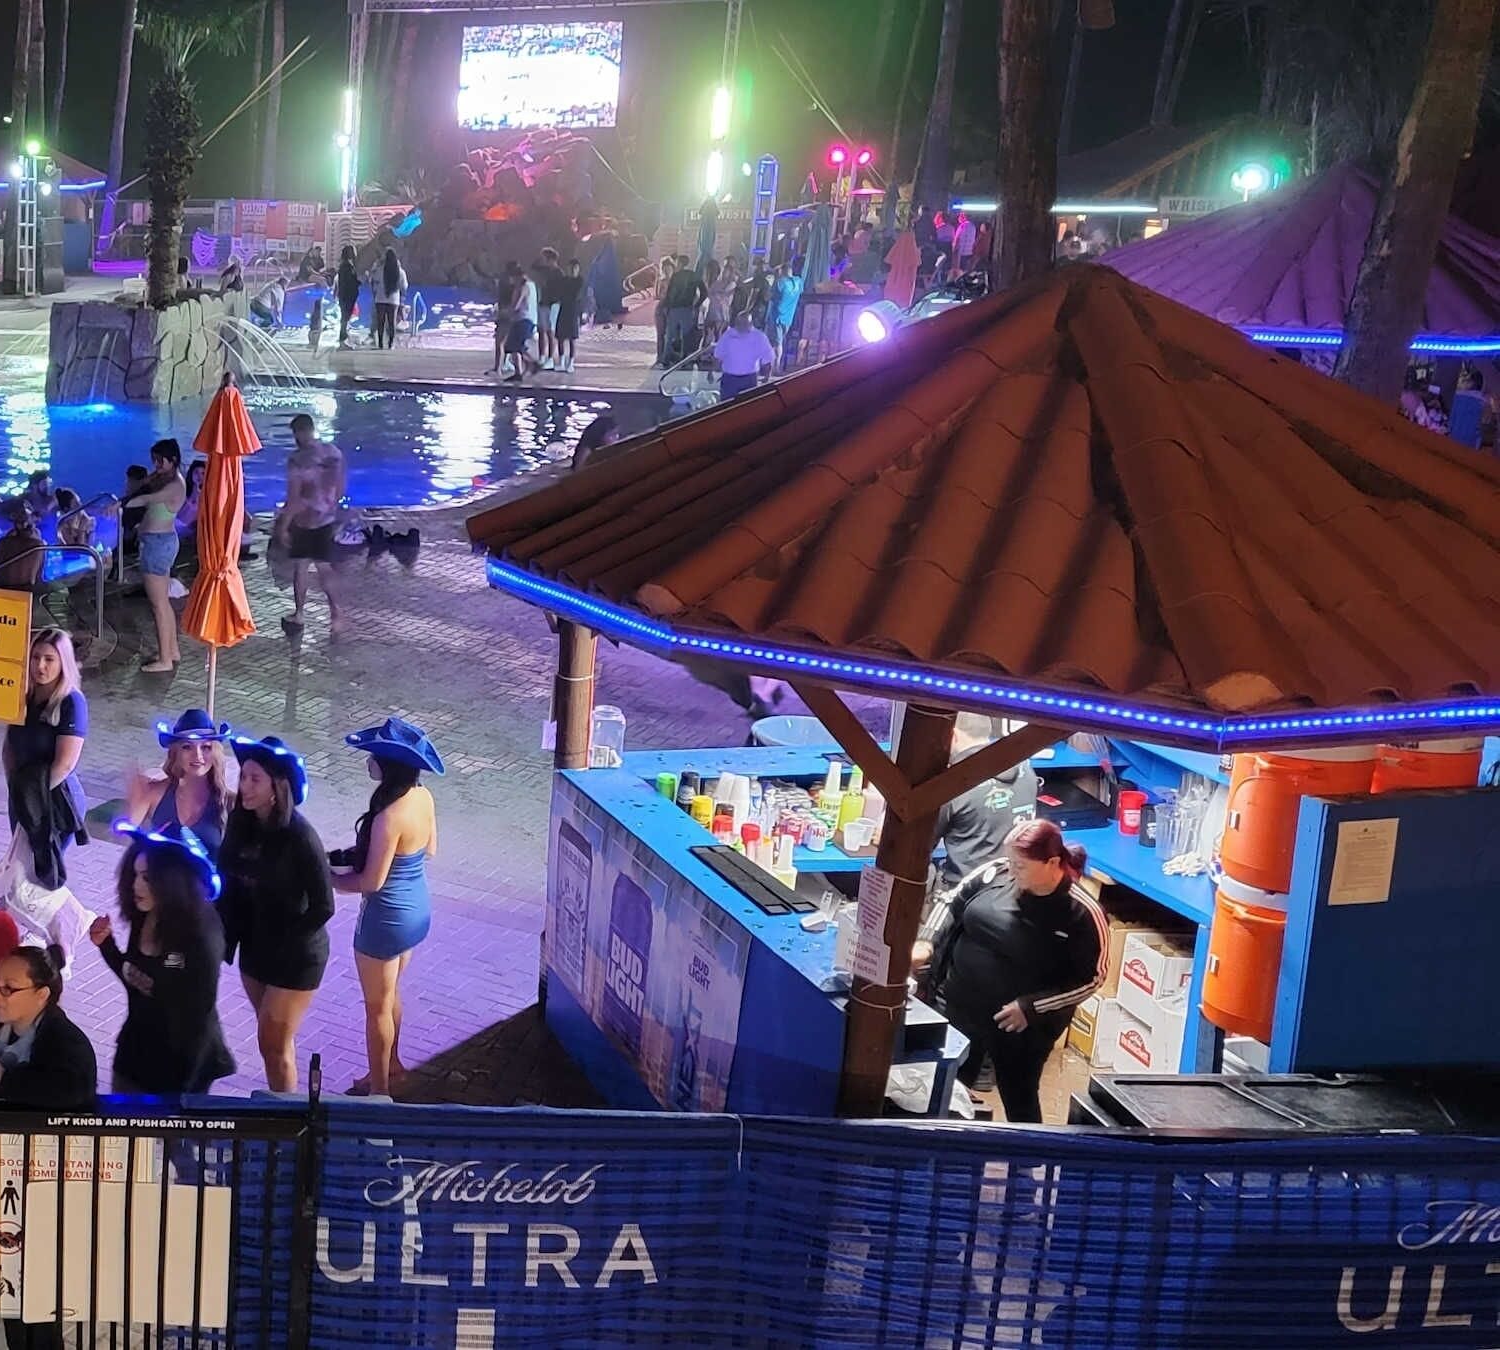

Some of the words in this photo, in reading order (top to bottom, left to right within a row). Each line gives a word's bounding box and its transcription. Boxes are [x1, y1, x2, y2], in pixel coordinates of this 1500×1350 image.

[611, 932, 644, 986] BUD
[688, 963, 711, 991] LIGHT
[693, 954, 710, 977] BUD
[605, 956, 645, 1018] LIGHT
[48, 1117, 71, 1126] LIFT
[73, 1117, 102, 1127] KNOB
[105, 1117, 128, 1127] AND
[130, 1118, 159, 1128] PUSH
[189, 1119, 204, 1129] TO
[206, 1120, 235, 1130] OPEN
[0, 1158, 43, 1168] SOCAL
[49, 1160, 124, 1171] DTANING
[363, 1156, 604, 1207] Michelob
[316, 1215, 658, 1289] ULTRA
